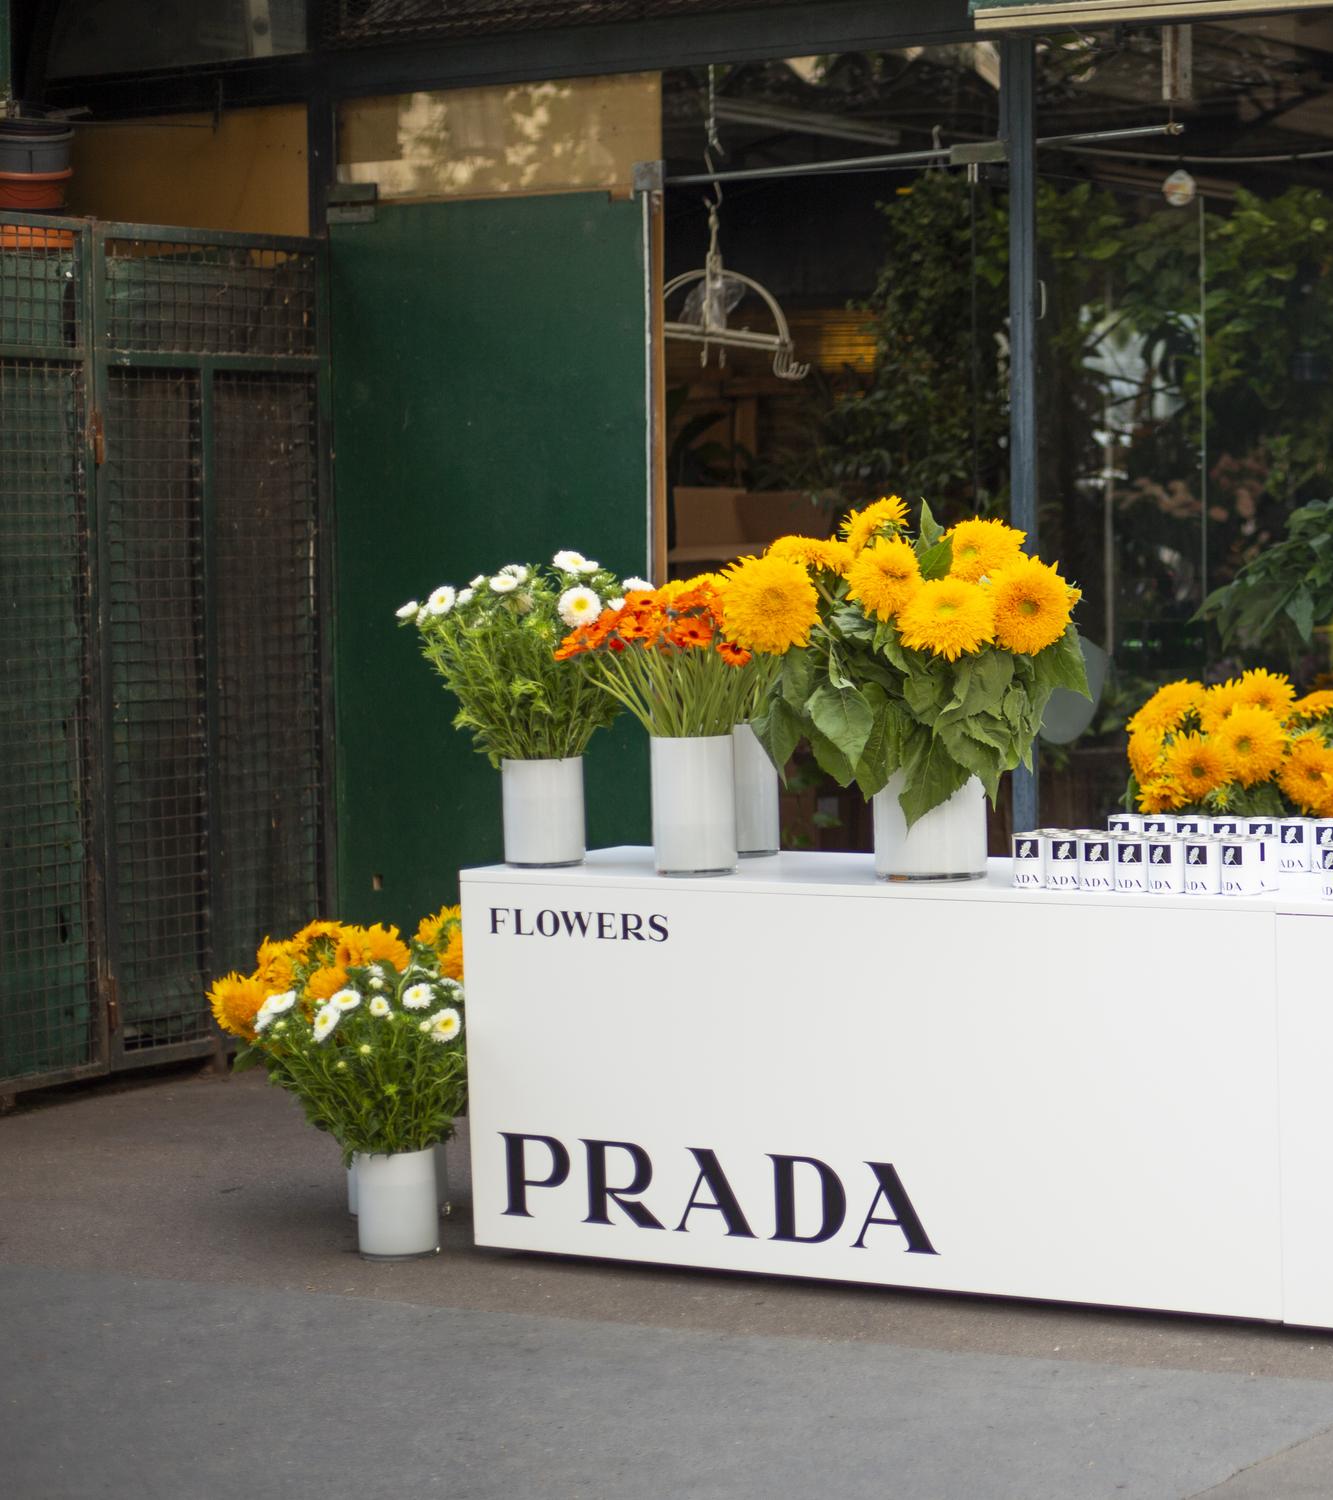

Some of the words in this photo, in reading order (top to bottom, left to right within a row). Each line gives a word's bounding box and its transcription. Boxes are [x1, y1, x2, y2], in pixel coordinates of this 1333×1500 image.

[1280, 859, 1304, 868] ADA
[1015, 874, 1039, 883] ADA
[1118, 879, 1142, 888] ADA
[1150, 880, 1172, 890] ADA
[490, 907, 669, 942] FLOWERS
[497, 1132, 941, 1255] PRADA
